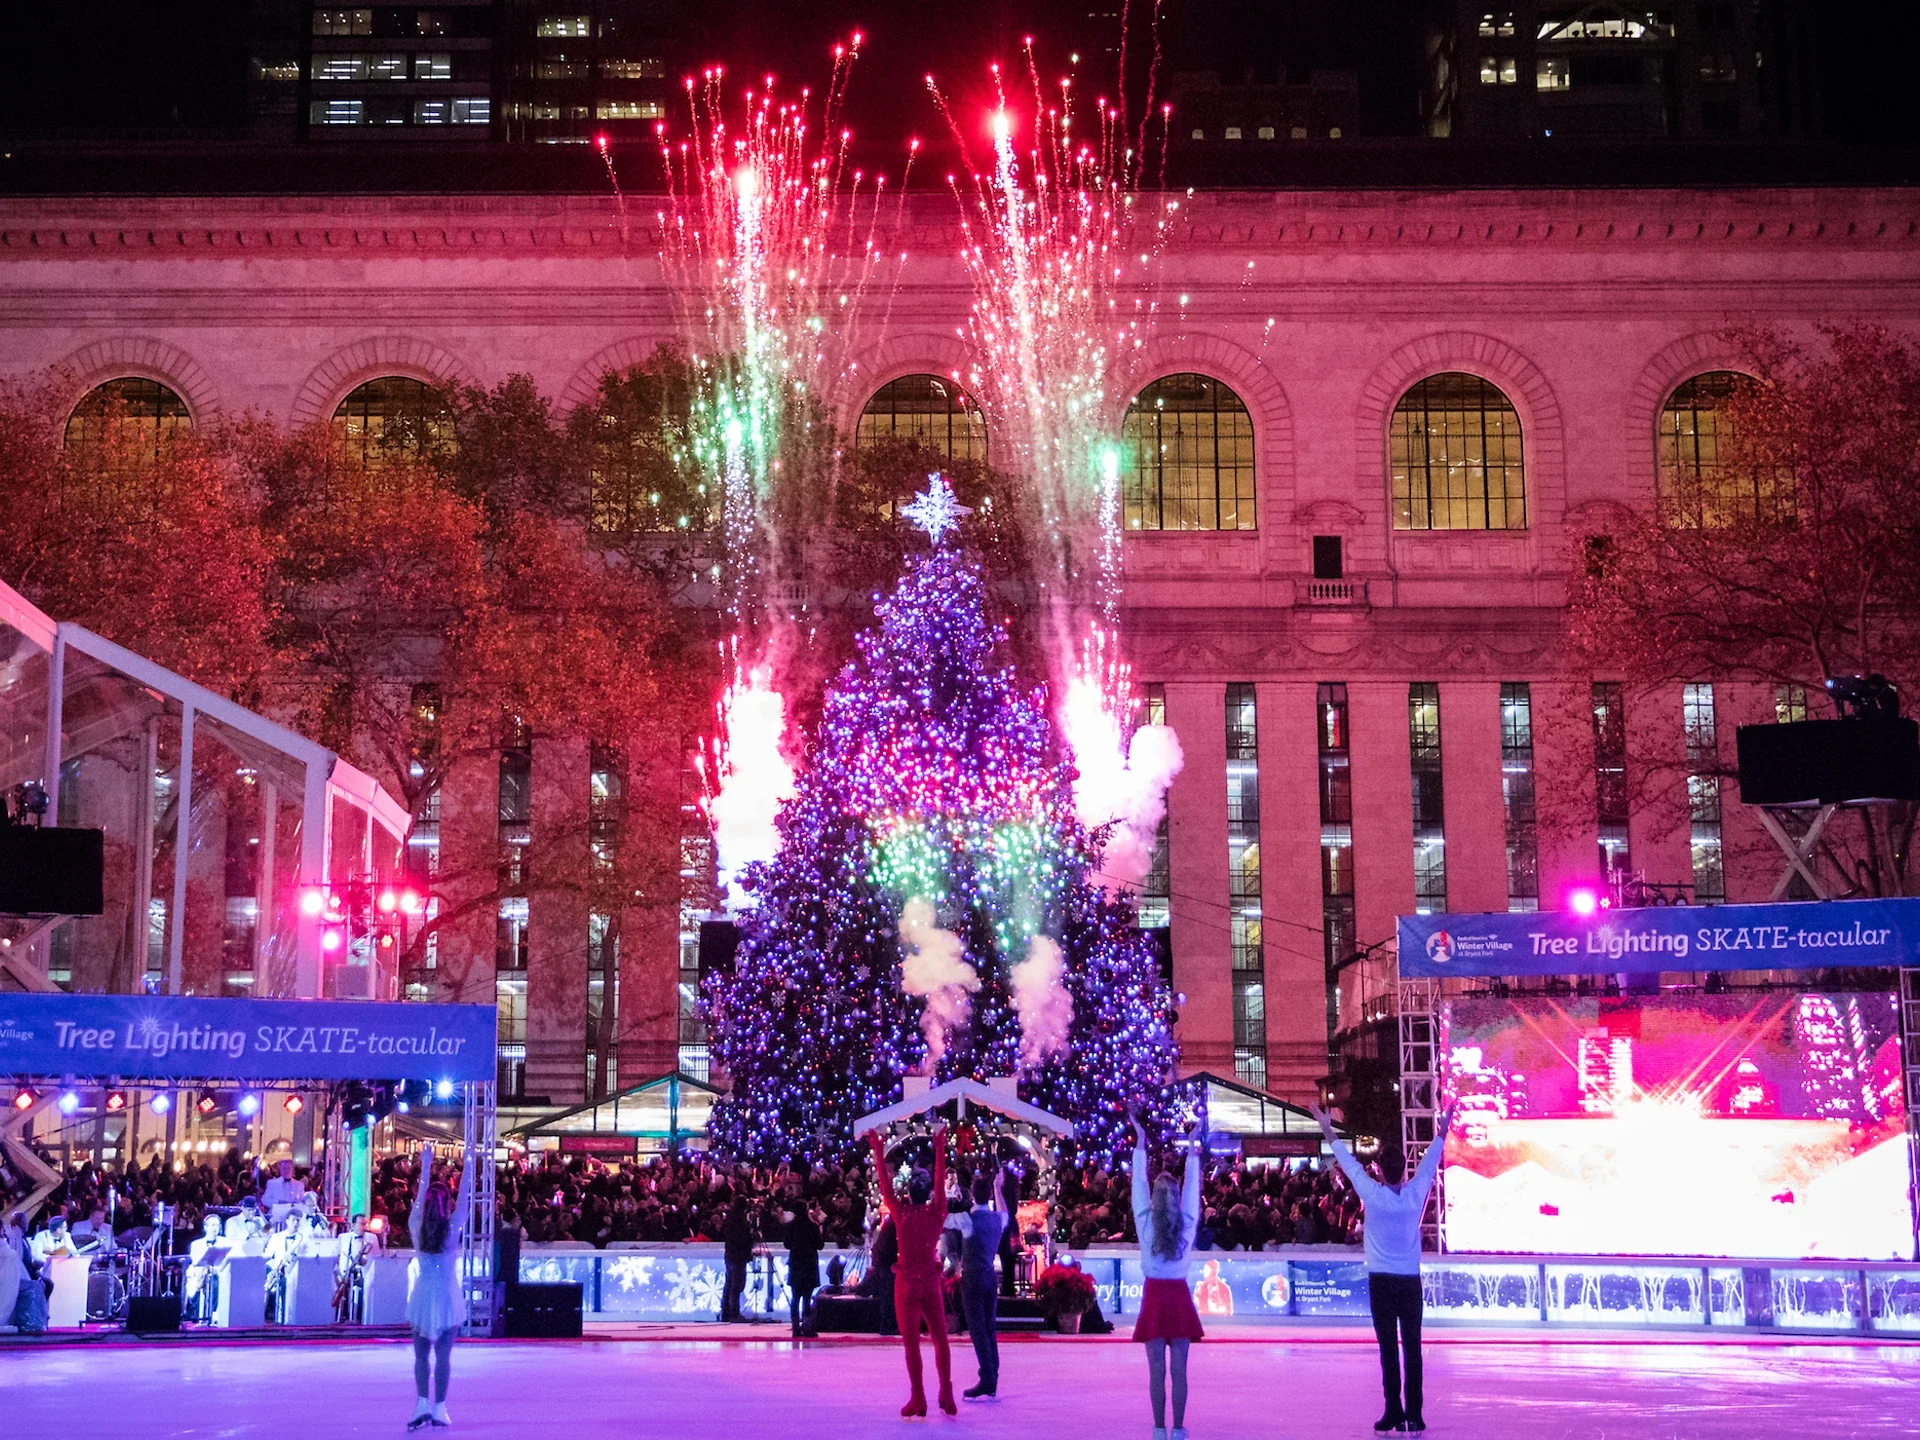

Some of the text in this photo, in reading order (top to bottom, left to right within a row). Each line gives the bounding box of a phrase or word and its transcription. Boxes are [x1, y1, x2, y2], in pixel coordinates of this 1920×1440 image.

[1456, 941, 1513, 951] Winter Village
[1528, 922, 1891, 959] Tree Lighting SKATE-tacular
[0, 1029, 34, 1041] Village
[55, 1021, 466, 1058] Tree Lighting SKATE-tacular
[1295, 1287, 1351, 1298] Winter Village
